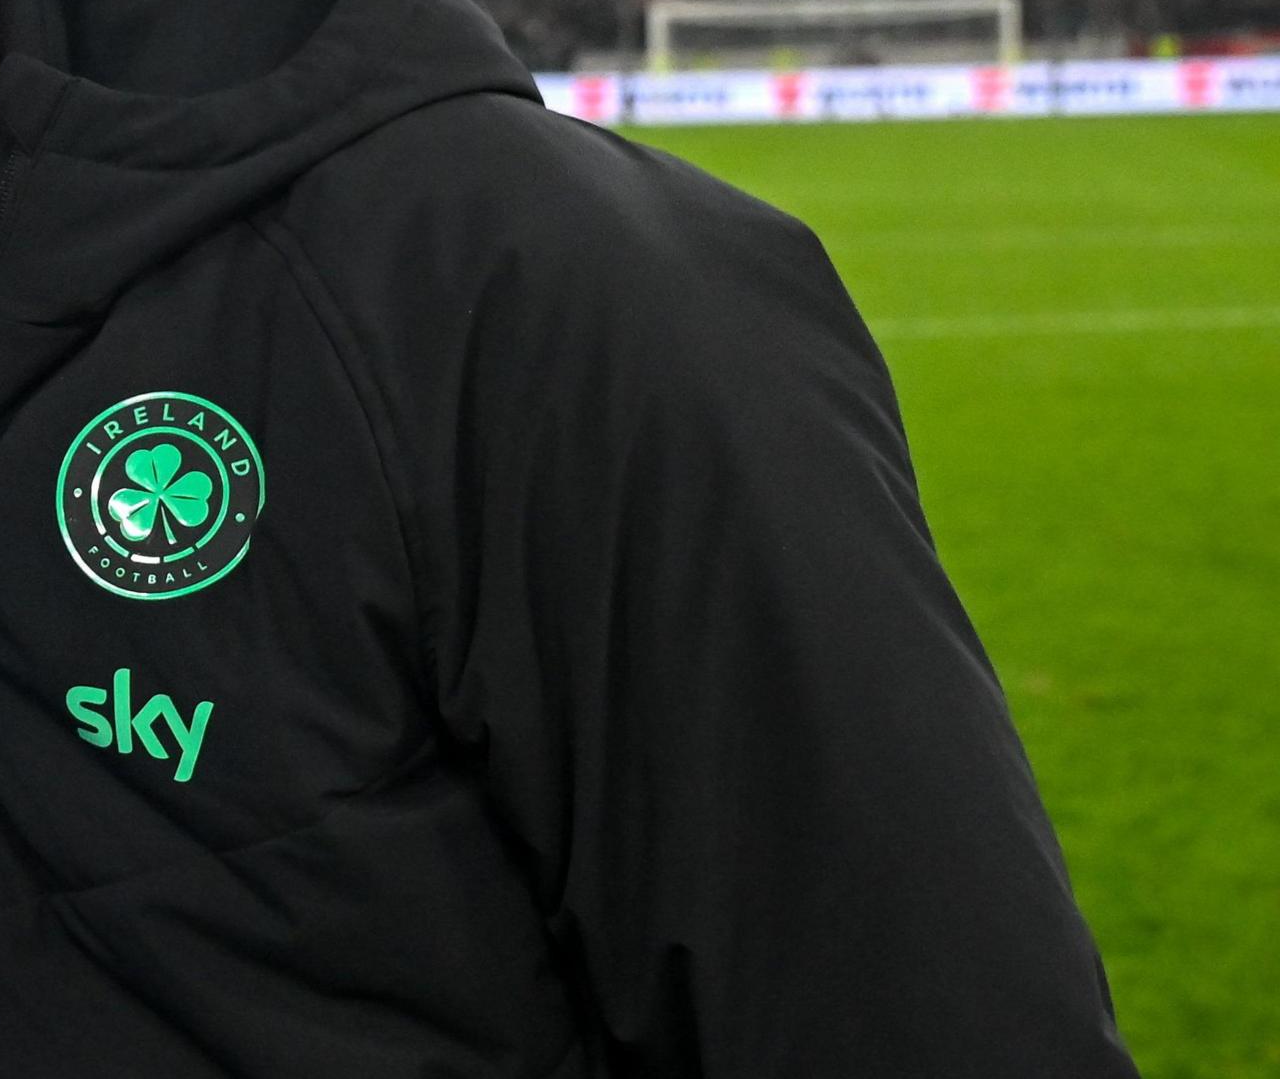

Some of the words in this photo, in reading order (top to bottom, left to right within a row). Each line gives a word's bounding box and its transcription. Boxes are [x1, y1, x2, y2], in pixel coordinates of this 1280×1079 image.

[86, 403, 251, 477] IRELAND
[87, 544, 209, 585] FOOTBALL
[65, 667, 215, 783] sky
